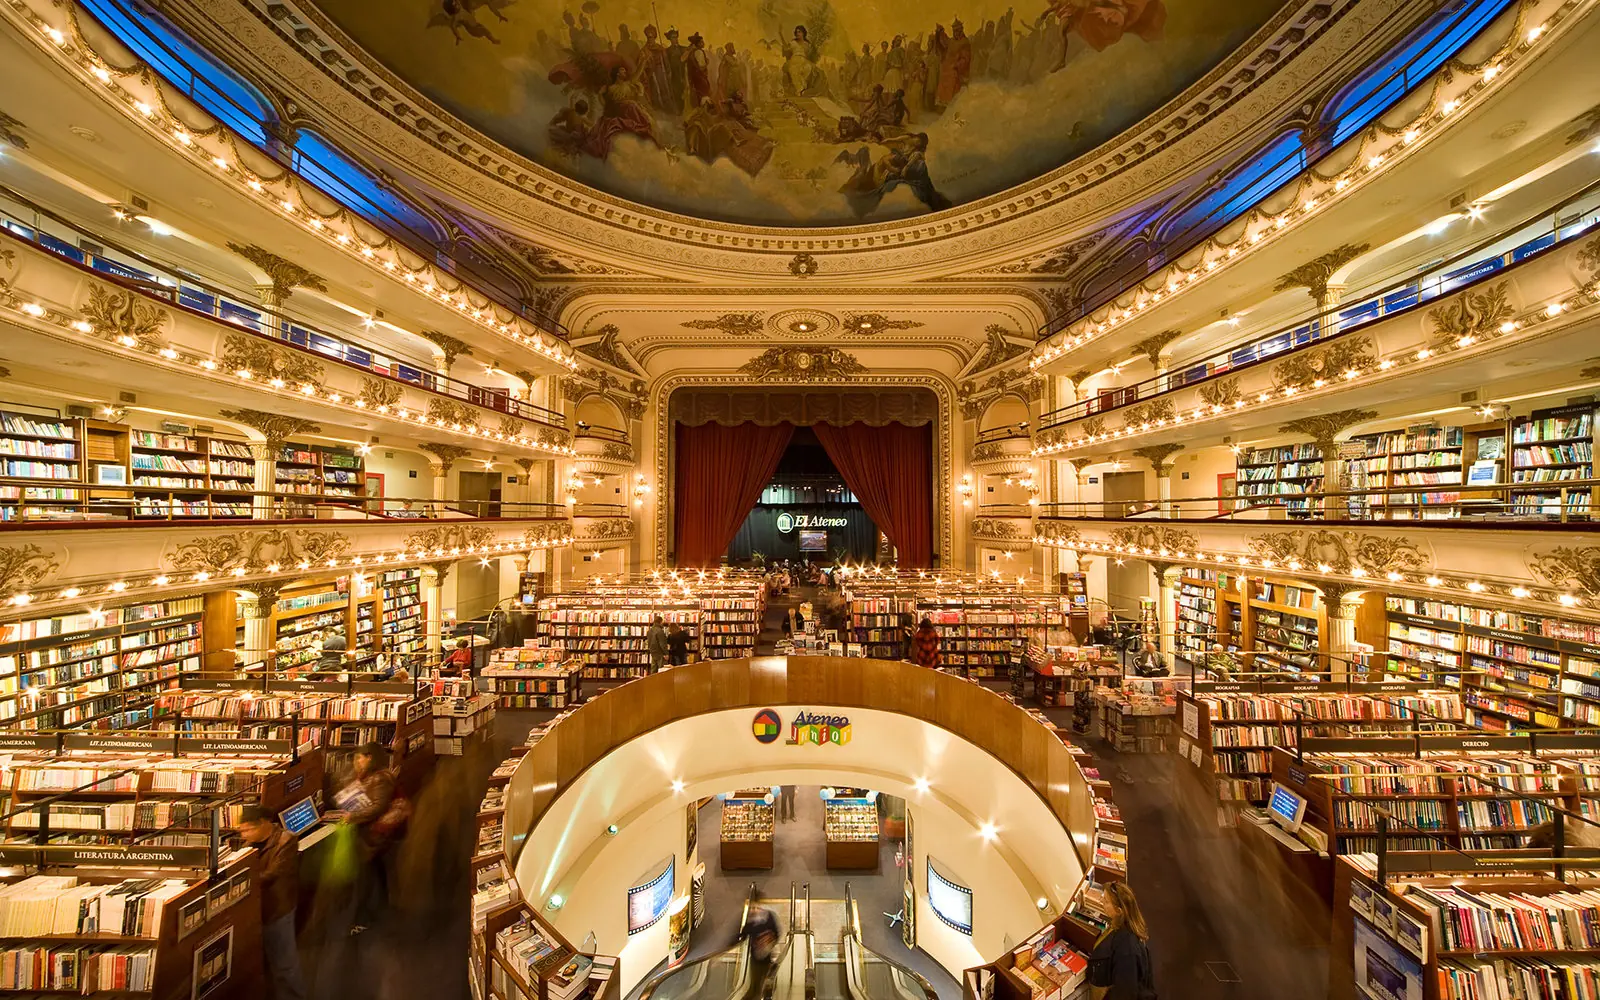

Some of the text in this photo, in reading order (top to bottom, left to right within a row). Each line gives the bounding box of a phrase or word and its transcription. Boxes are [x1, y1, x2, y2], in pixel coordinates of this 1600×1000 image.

[794, 515, 847, 527] El Ateneo
[63, 633, 91, 642] POLICIALES
[1490, 631, 1524, 641] DICCIONARIOS
[793, 711, 849, 726] Ateneo
[101, 740, 152, 748] LATINOAMERICANA
[74, 852, 174, 860] LITERATURA ARGENTINA
